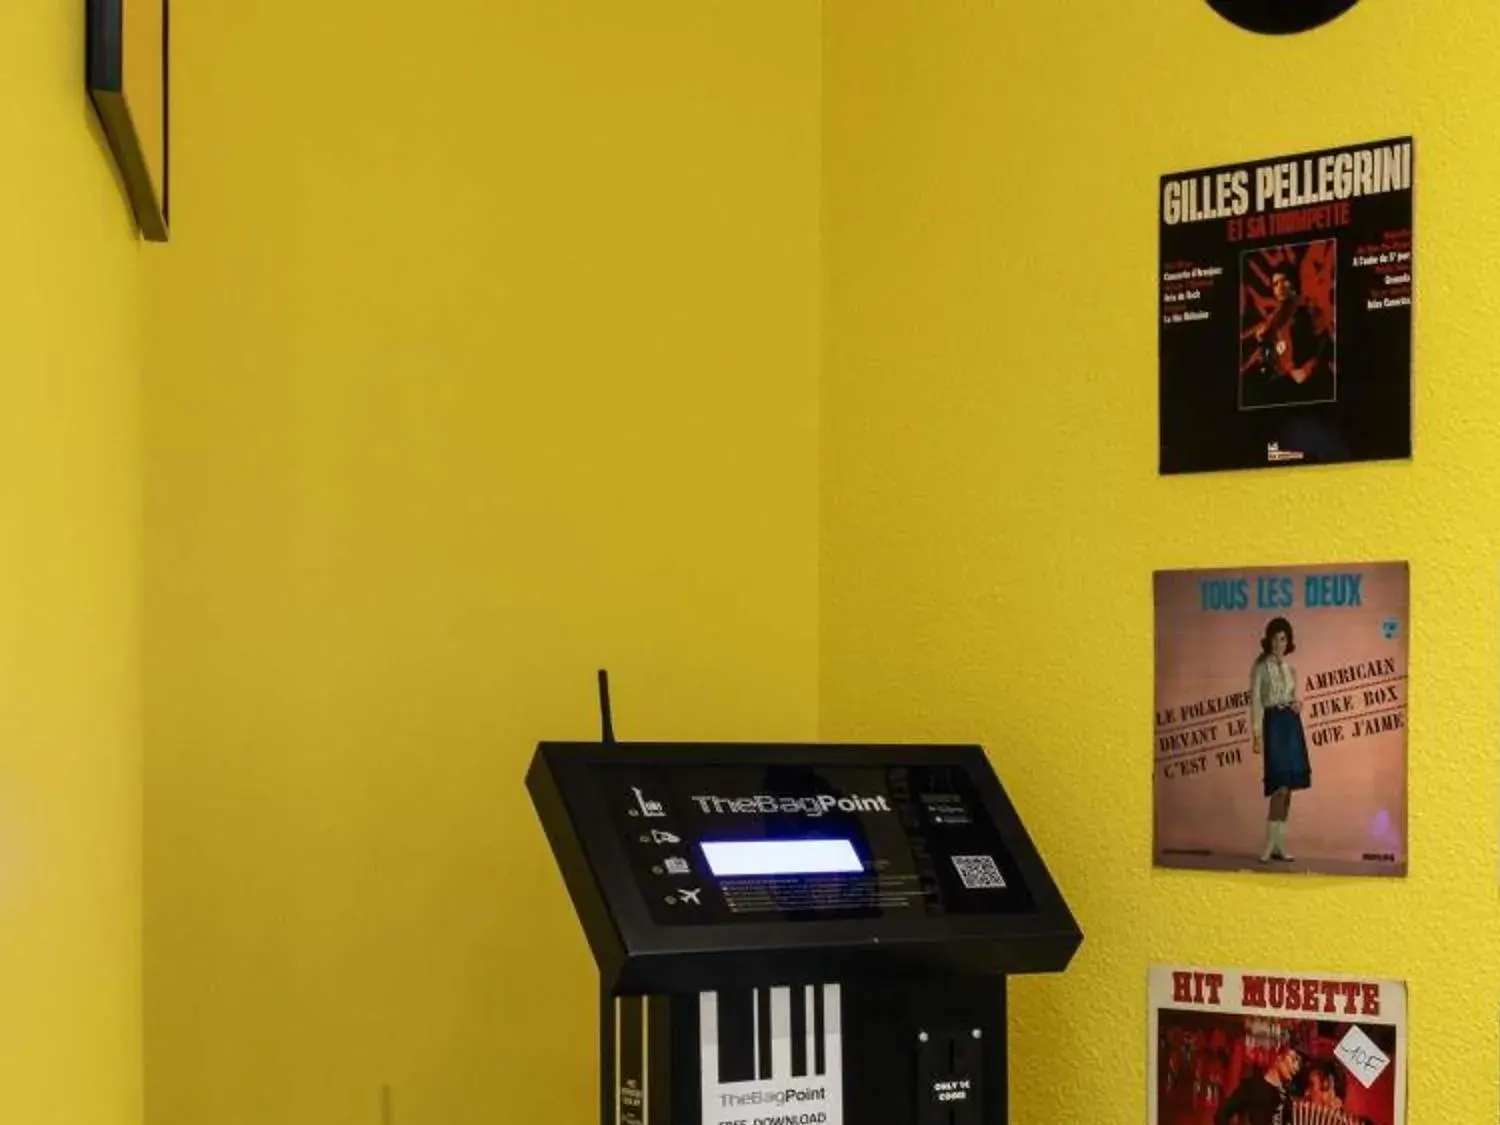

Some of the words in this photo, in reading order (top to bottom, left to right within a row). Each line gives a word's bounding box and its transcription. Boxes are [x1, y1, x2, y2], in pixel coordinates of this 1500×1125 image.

[1164, 170, 1249, 225] GILLES
[1256, 144, 1411, 211] PELLEGRINI
[1200, 579, 1248, 611] TOUS
[1257, 577, 1293, 609] LES
[1304, 574, 1362, 608] DEUX
[1305, 657, 1395, 692] AMERICAIN
[1156, 708, 1176, 726] LE
[1310, 696, 1354, 719] JUKE
[1364, 686, 1398, 707] BOX
[1159, 725, 1218, 752] DEVANT
[1227, 719, 1247, 736] LE
[1311, 725, 1345, 746] QUE
[1352, 711, 1404, 737] J'AIME
[1164, 755, 1207, 778] C'EST
[1216, 747, 1242, 767] TOI
[692, 794, 891, 816] TheBagPoint
[1173, 971, 1223, 1005] HIT
[1241, 975, 1380, 1016] MUSETTE
[720, 1087, 825, 1107] TheBagPoint
